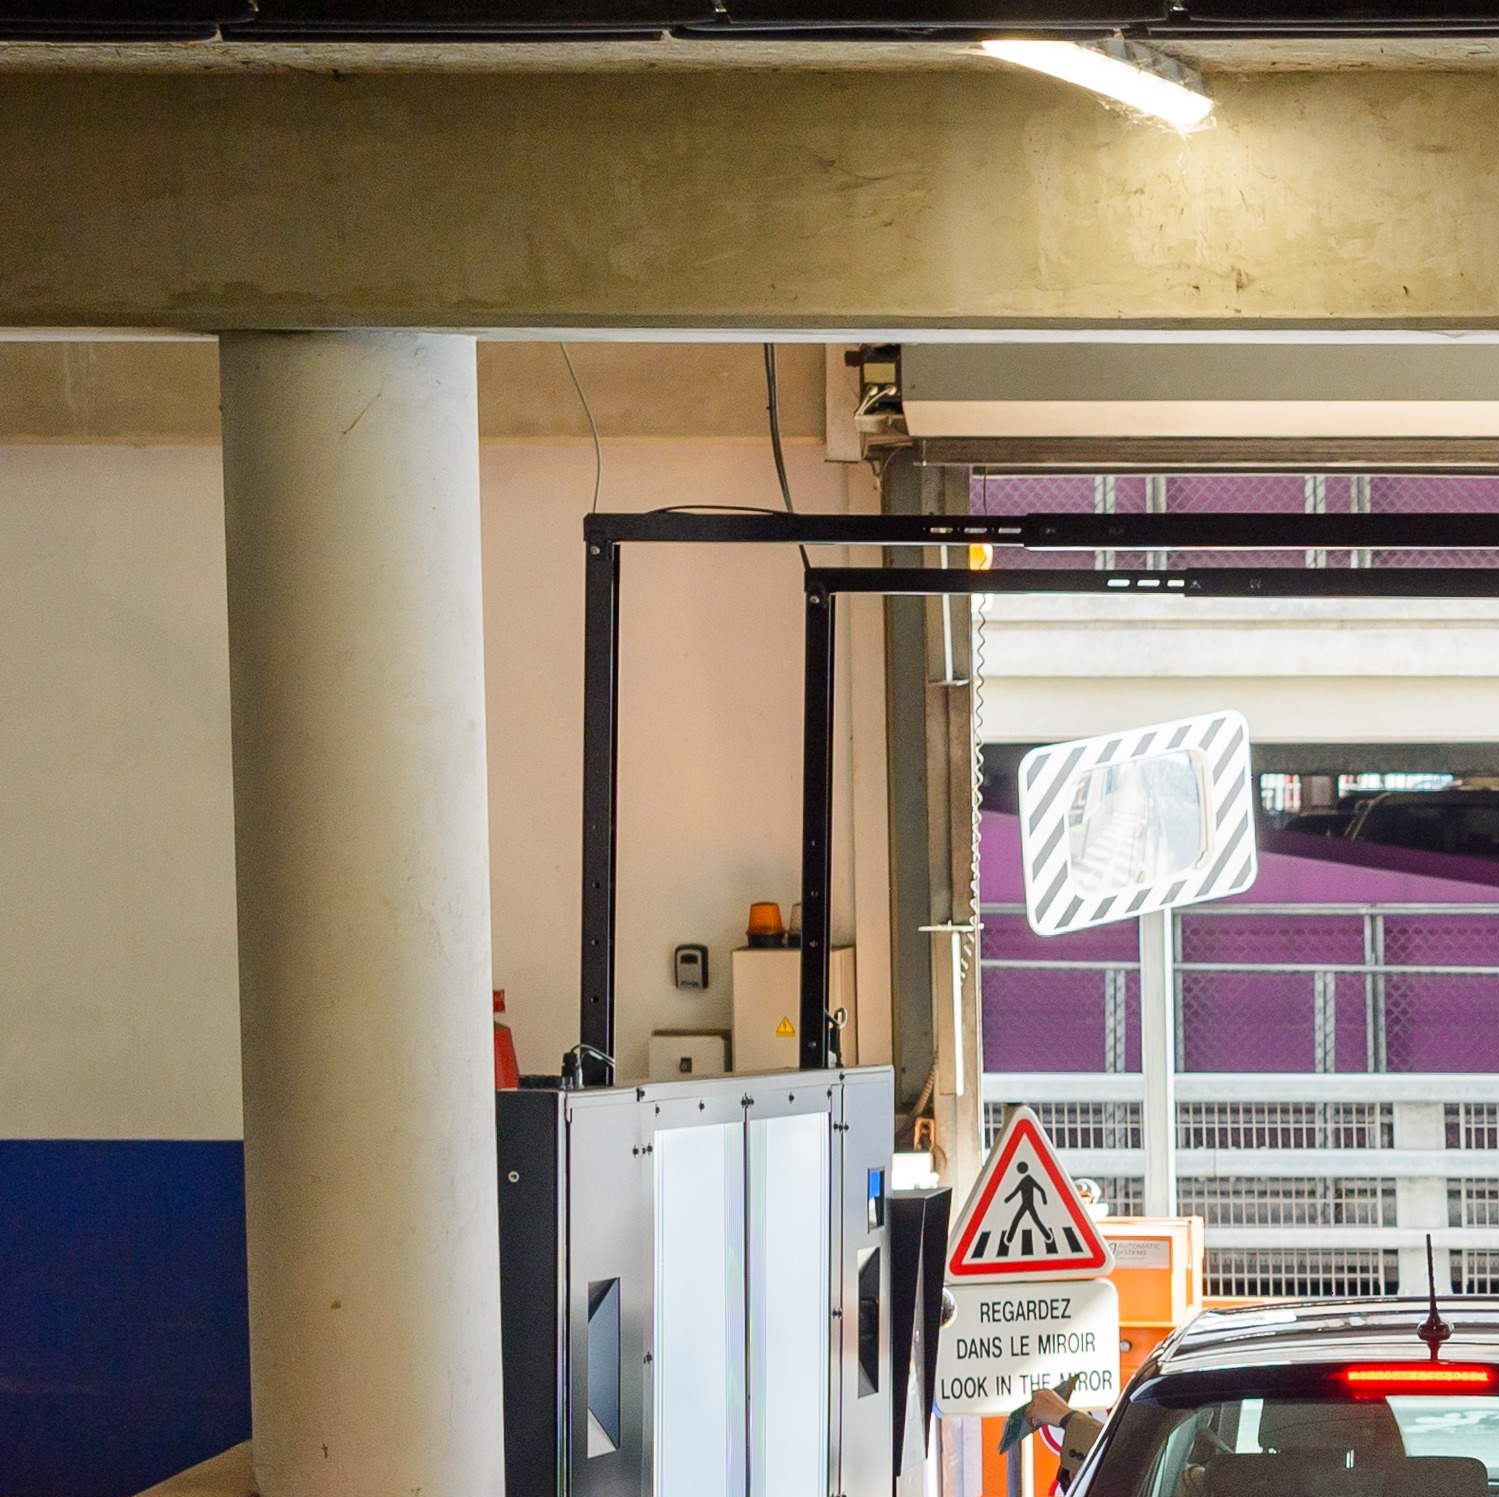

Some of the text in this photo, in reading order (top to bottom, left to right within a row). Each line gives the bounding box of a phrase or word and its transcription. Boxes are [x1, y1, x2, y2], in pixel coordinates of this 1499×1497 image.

[980, 1298, 1071, 1323] REGARDEZ
[957, 1332, 1096, 1360] DANS LE MIROIR
[941, 1376, 988, 1400] LOOK
[996, 1375, 1011, 1396] IN
[1019, 1373, 1051, 1395] THE
